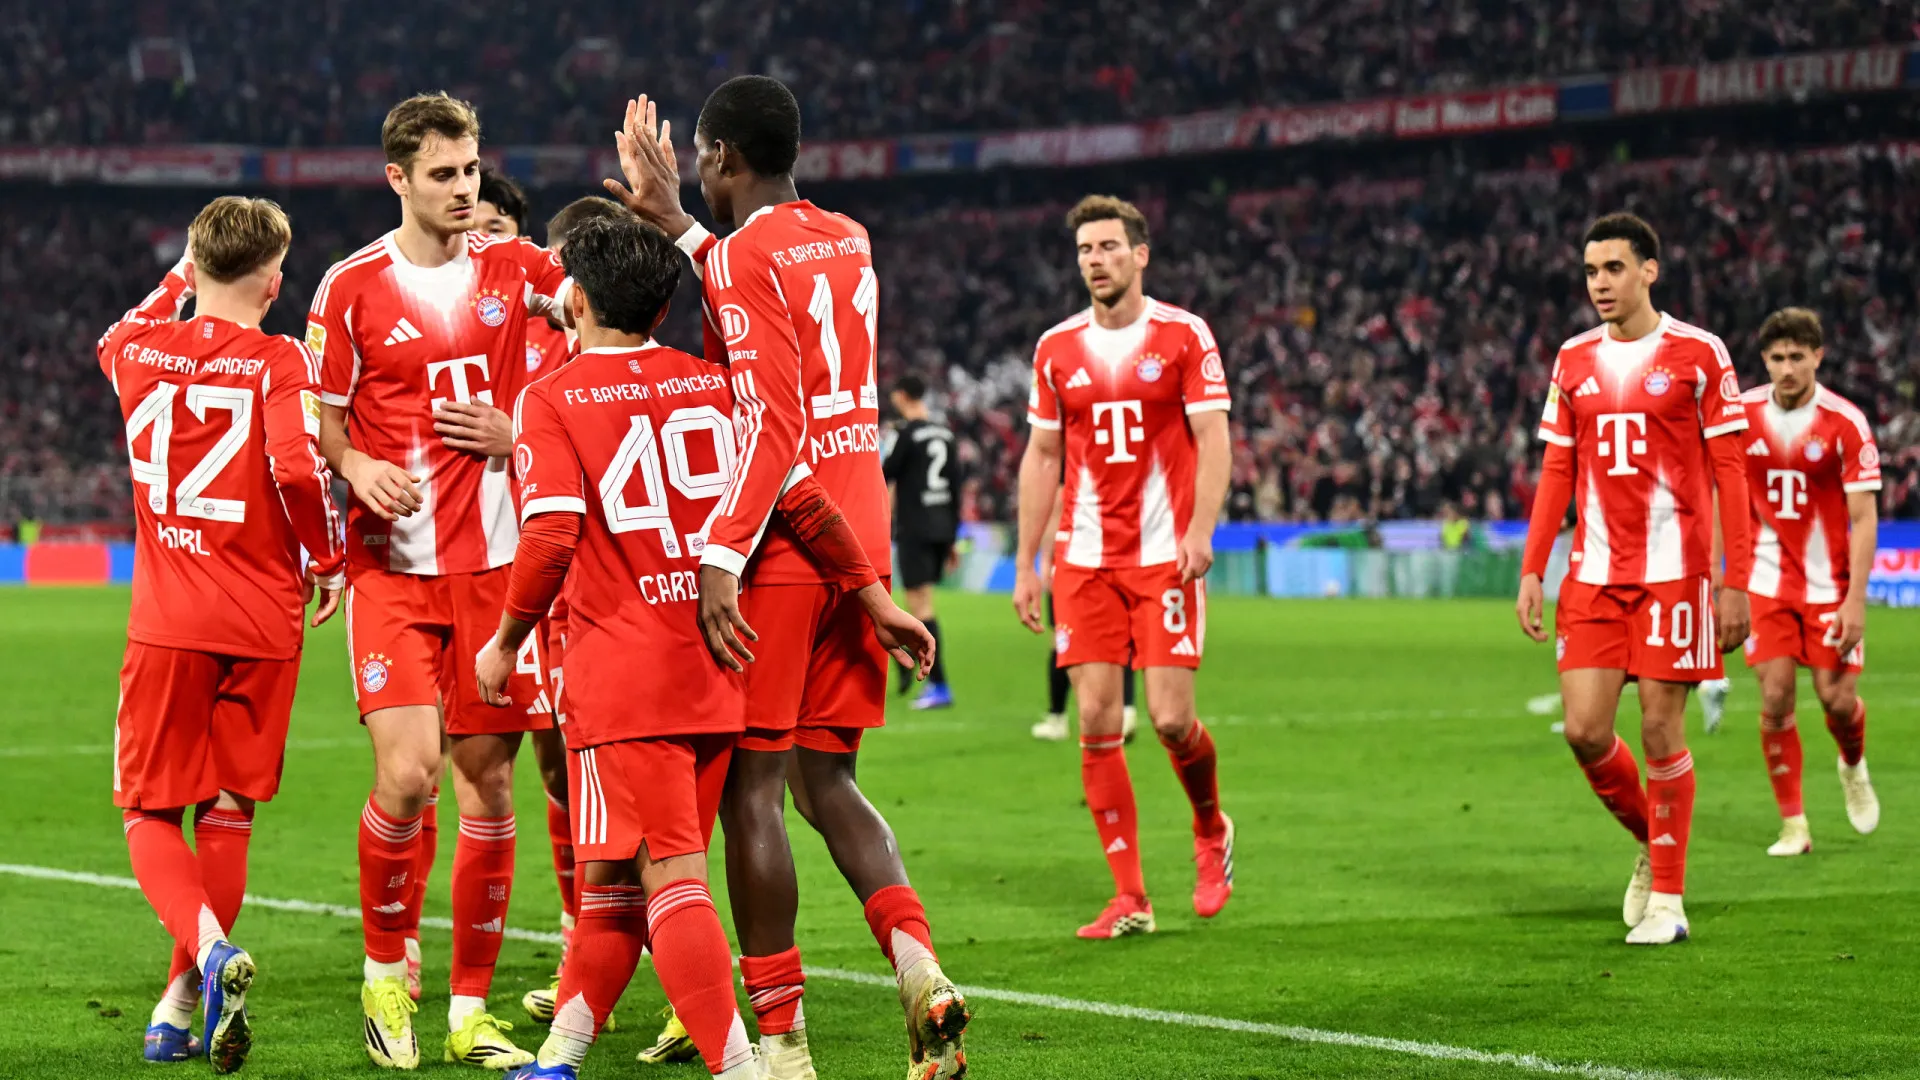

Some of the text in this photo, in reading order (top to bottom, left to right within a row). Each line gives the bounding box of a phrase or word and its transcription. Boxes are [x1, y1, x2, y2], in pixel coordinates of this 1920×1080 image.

[772, 250, 791, 268] FC
[788, 240, 835, 263] BAYERN
[123, 343, 140, 361] FC
[138, 349, 198, 376] BAYERN
[807, 266, 879, 420] 11
[564, 388, 589, 405] FC
[590, 384, 653, 403] BAYERN
[126, 381, 254, 523] 42
[1092, 400, 1145, 464] T
[1596, 412, 1647, 476] T
[599, 405, 738, 559] 49
[926, 438, 950, 492] 2
[1767, 469, 1808, 520] T
[1161, 587, 1187, 634] 8
[1646, 600, 1694, 649] 10
